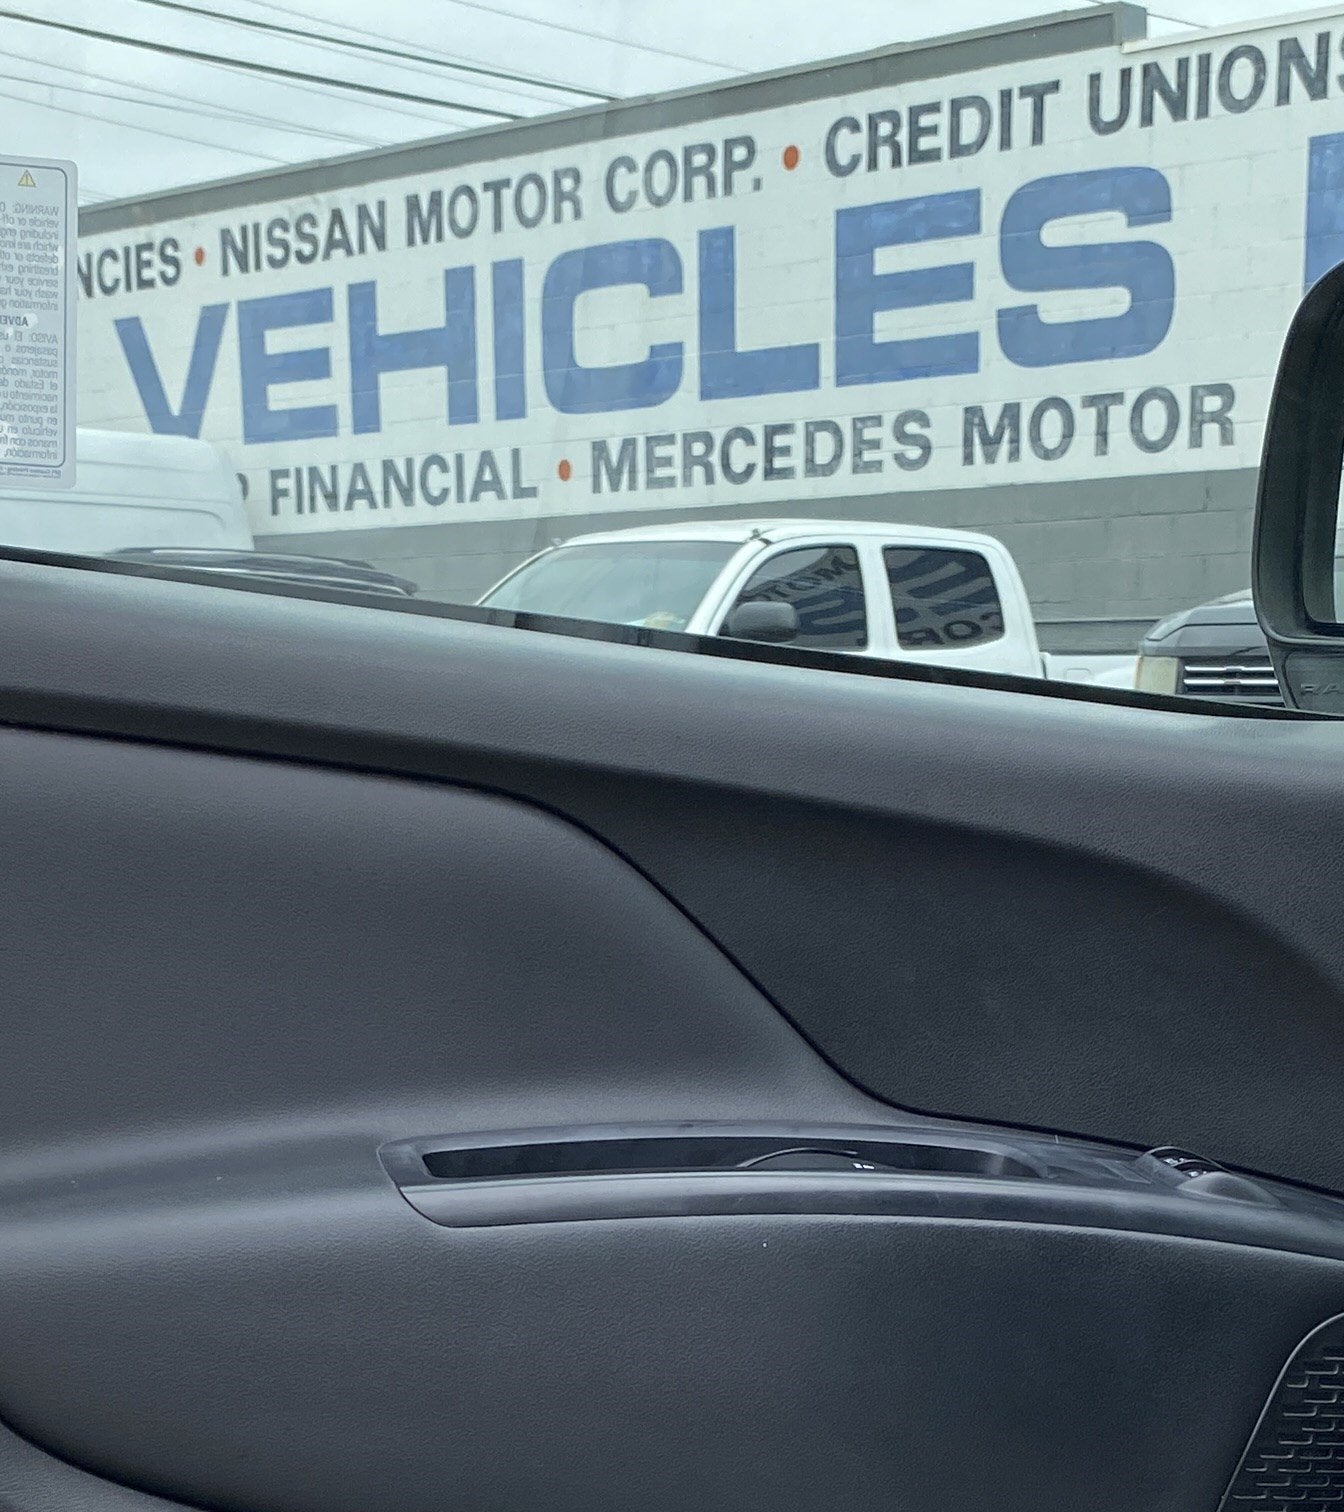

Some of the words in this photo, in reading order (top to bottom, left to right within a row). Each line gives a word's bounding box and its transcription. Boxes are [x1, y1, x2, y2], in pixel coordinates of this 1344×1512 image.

[219, 193, 387, 277] NISSAN
[406, 168, 582, 248] MOTOR
[606, 135, 763, 215] CORP.
[824, 79, 1060, 178] CREDIT
[114, 166, 1176, 445] VEHICLES
[270, 445, 538, 517] FINANCIAL
[591, 410, 933, 495] MERCEDES
[963, 383, 1236, 468] MOTOR
